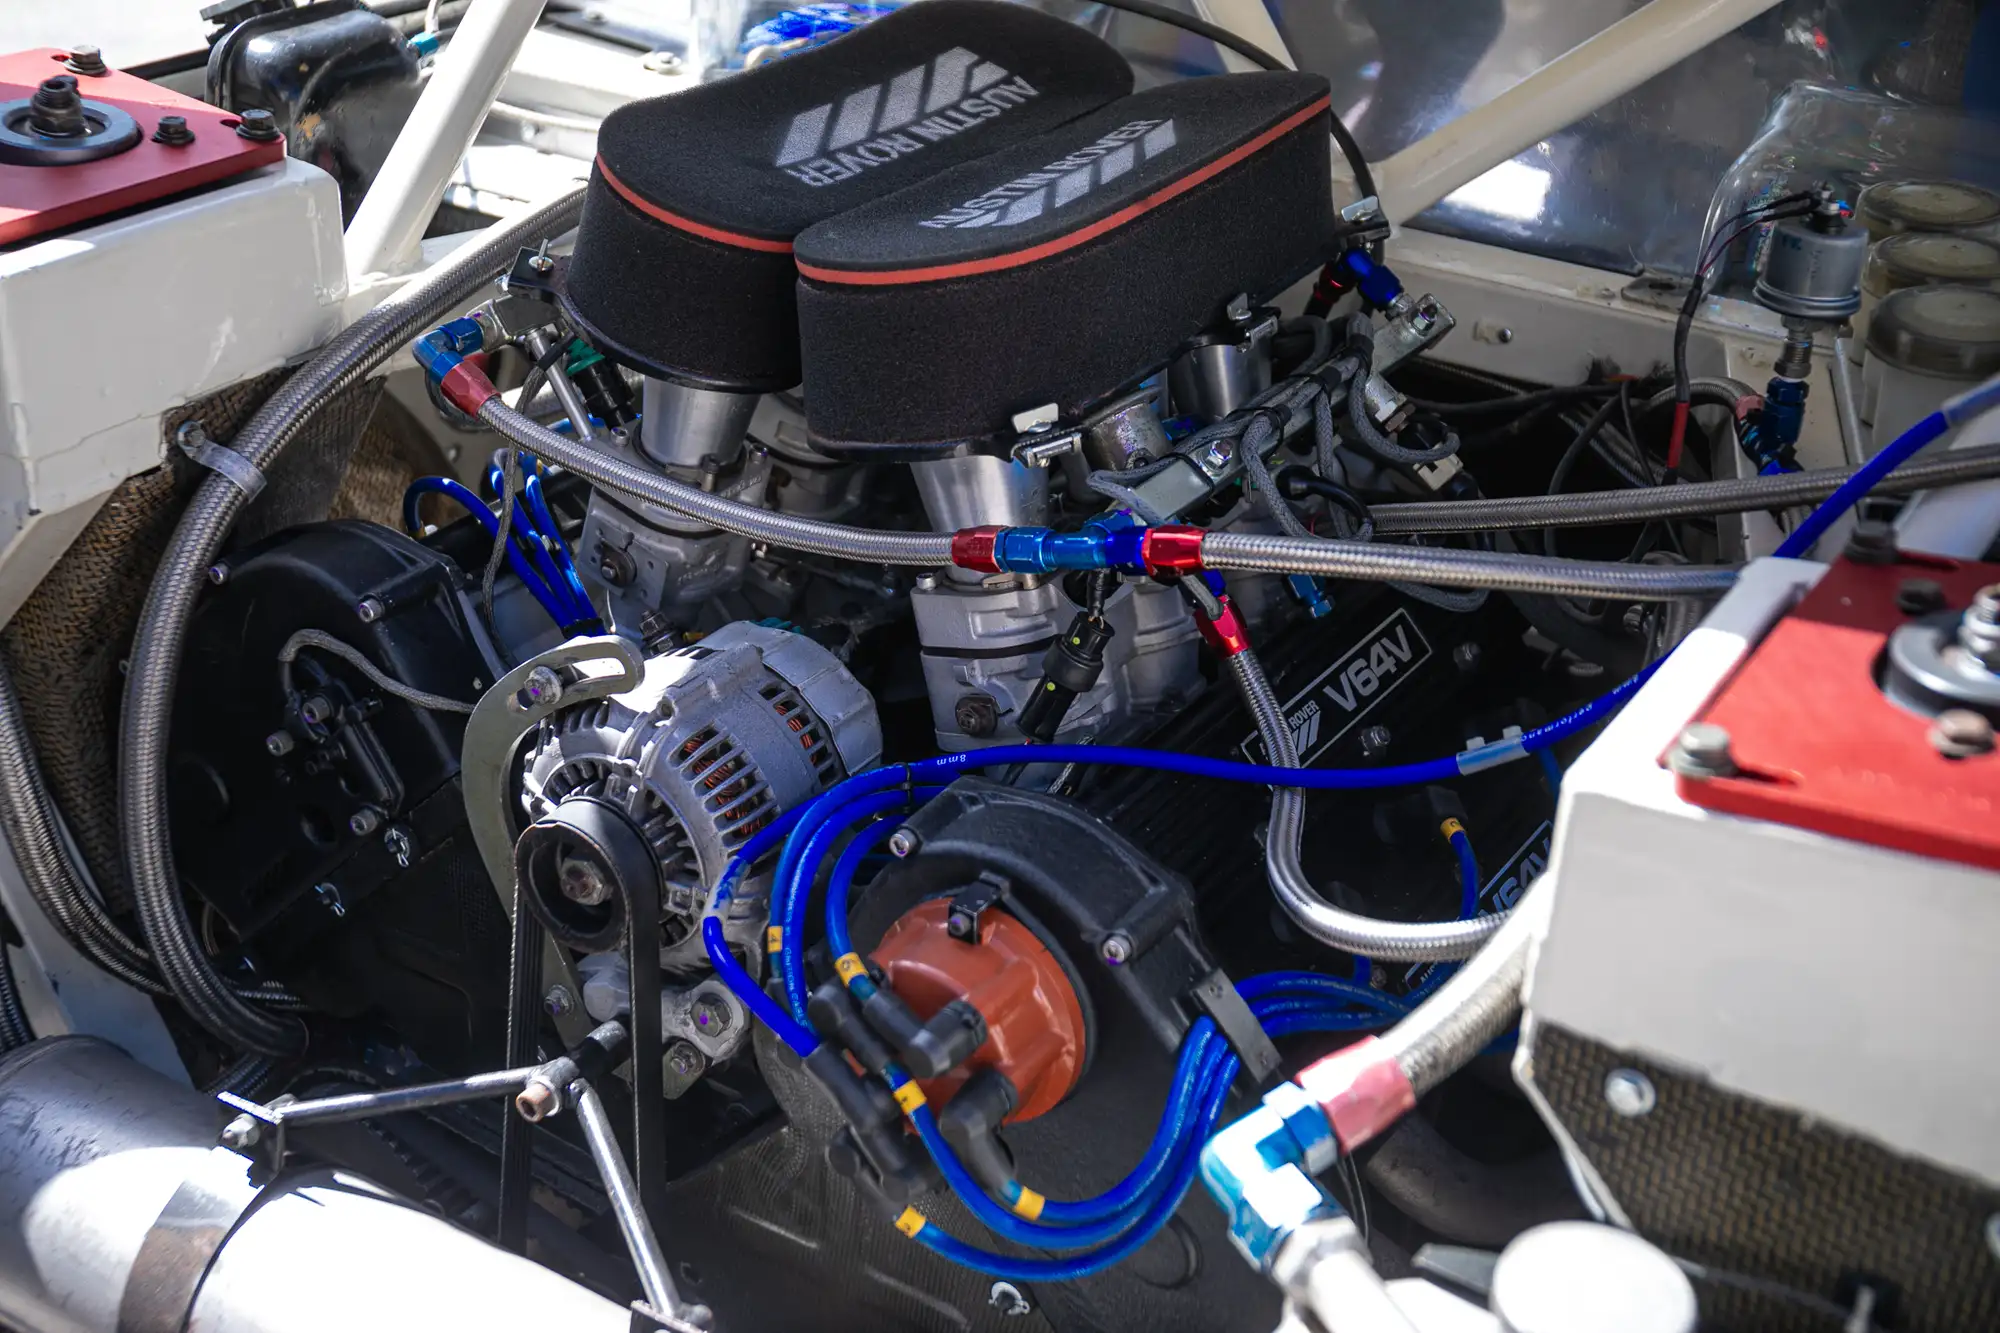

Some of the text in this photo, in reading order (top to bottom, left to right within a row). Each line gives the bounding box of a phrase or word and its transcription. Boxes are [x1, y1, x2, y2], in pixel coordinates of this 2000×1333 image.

[784, 75, 1040, 187] AUSTIN ROVER
[917, 119, 1164, 229] AUSTIN ROVER
[1323, 614, 1413, 702] V64V
[1288, 700, 1319, 729] ROVER
[1519, 702, 1594, 743] performanc
